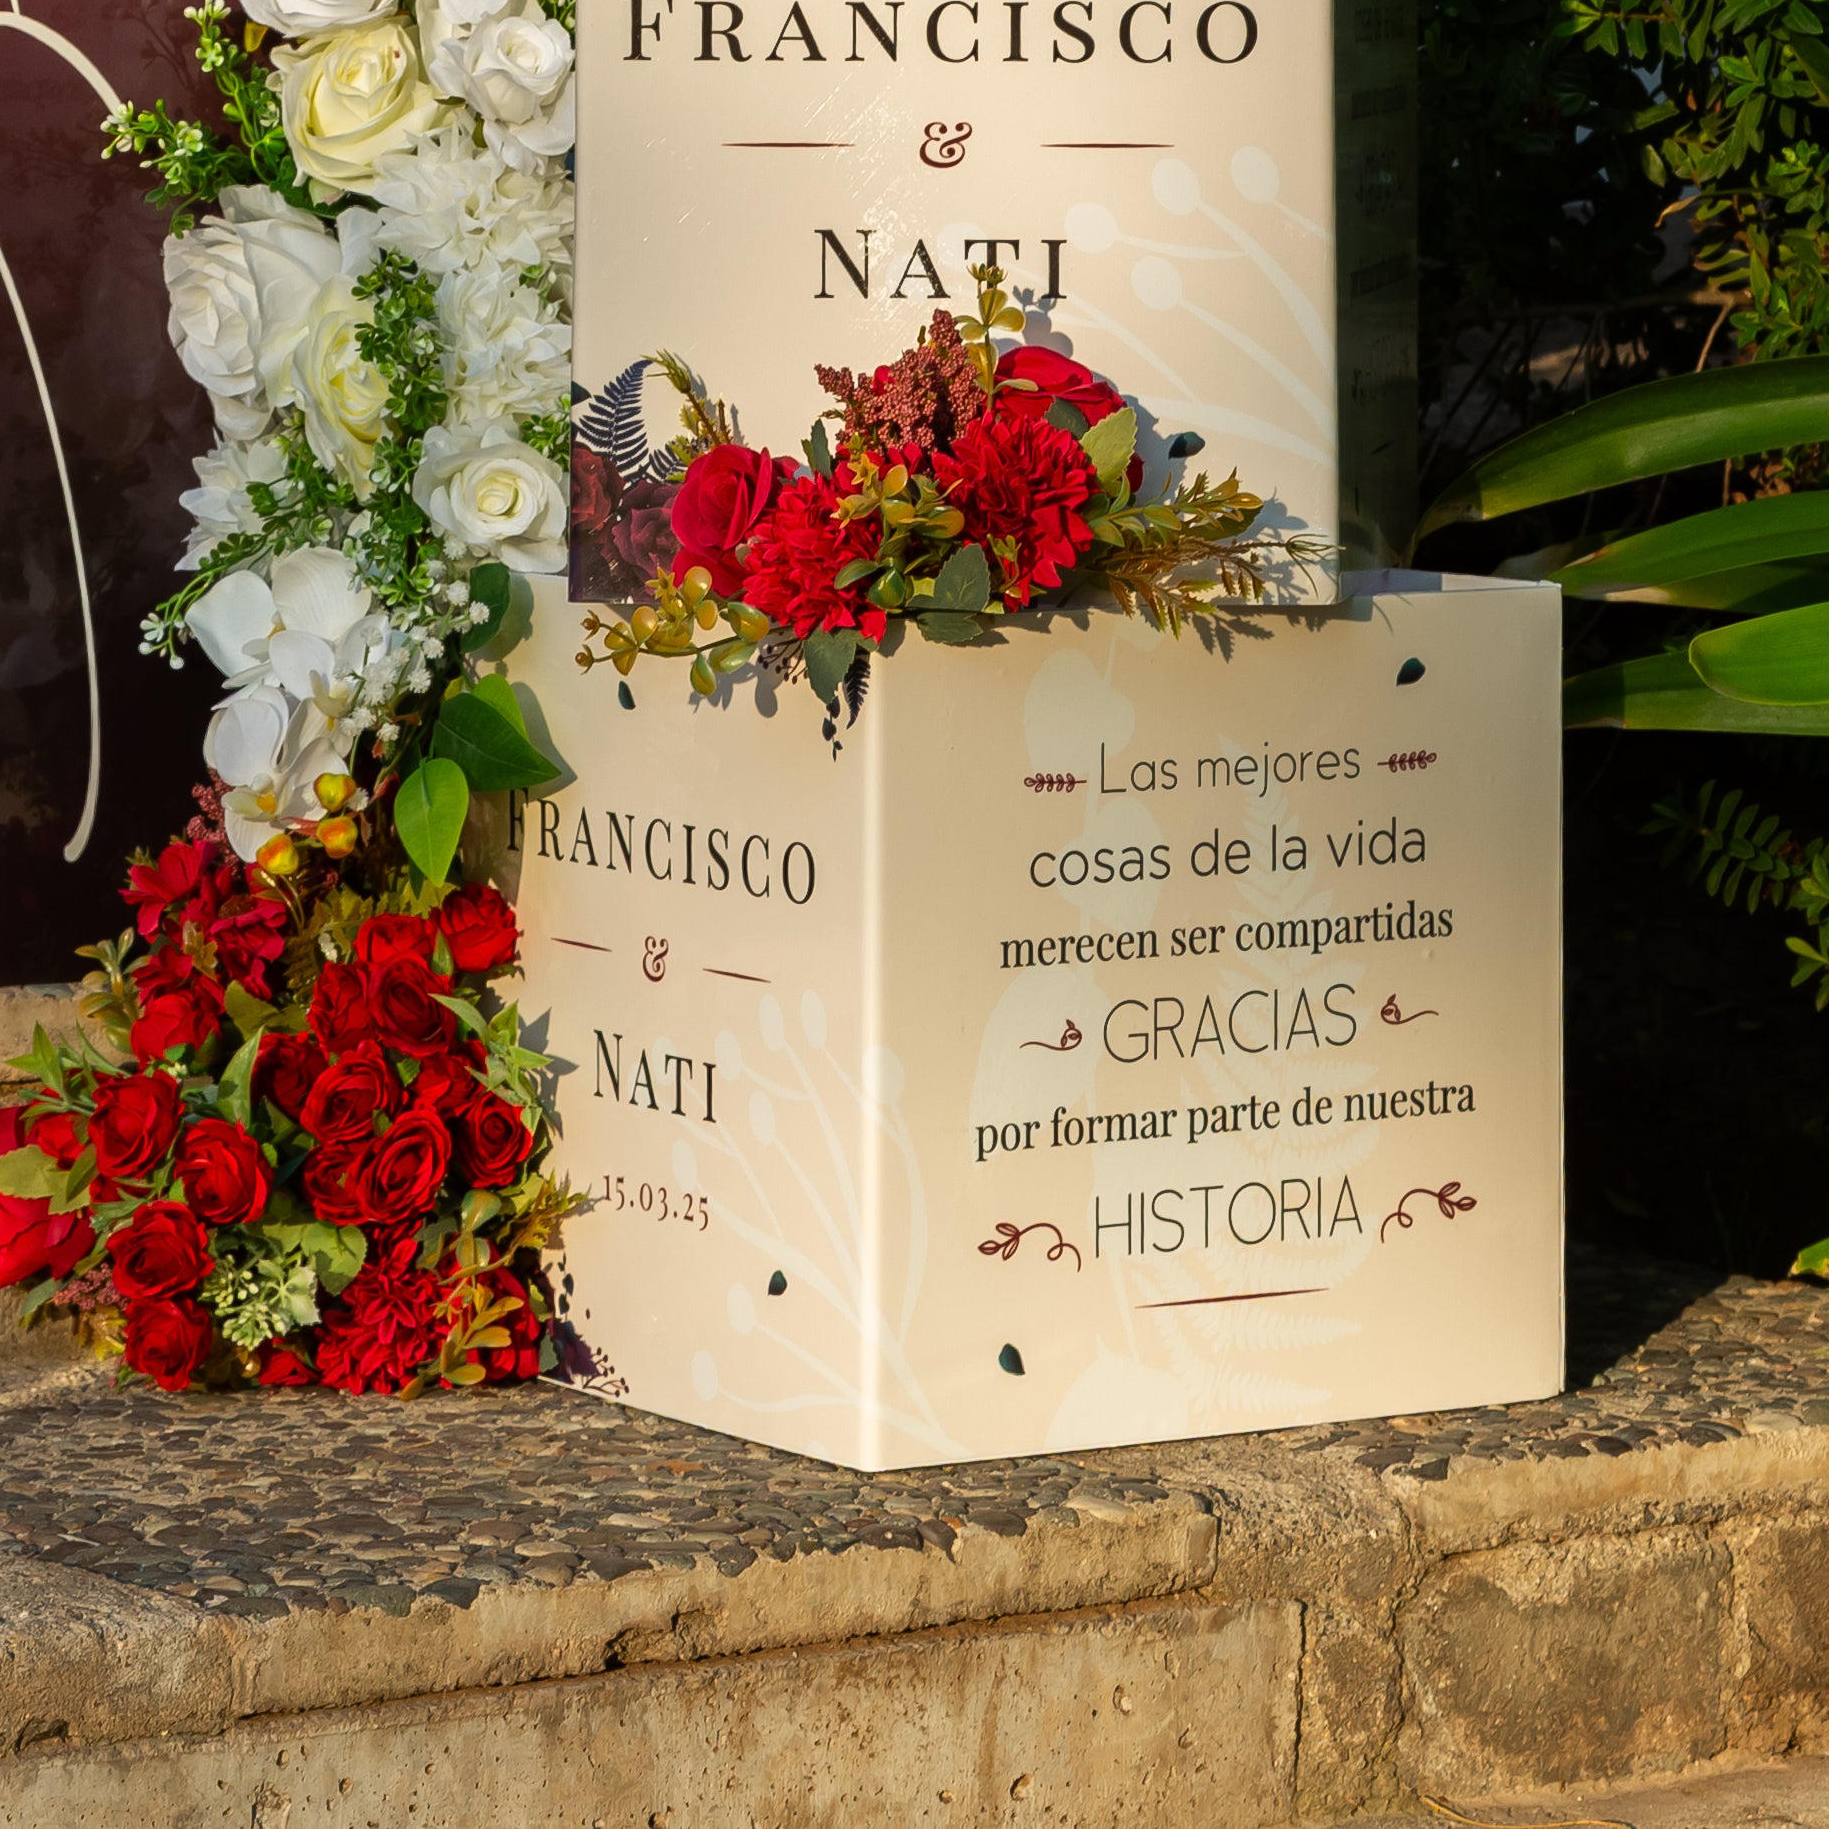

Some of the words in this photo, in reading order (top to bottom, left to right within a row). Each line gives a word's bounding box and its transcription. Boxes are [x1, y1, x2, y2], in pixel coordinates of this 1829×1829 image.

[919, 121, 973, 169] &
[813, 229, 1068, 300] NATI
[1100, 742, 1178, 794] Las
[1197, 741, 1361, 798] mejores
[506, 785, 816, 907] FRANCISCO
[1029, 844, 1171, 888] cosas
[1190, 827, 1251, 877] de
[1271, 824, 1307, 872] la
[1326, 816, 1426, 868] vida
[642, 935, 669, 983] &
[1000, 930, 1160, 969] merecen
[1170, 925, 1226, 957] ser
[1235, 899, 1453, 955] compartidas
[1103, 983, 1357, 1064] GRACIAS
[593, 1029, 717, 1124] NATI
[975, 1120, 1041, 1163] por
[1050, 1106, 1178, 1148] formar
[1187, 1095, 1281, 1144] parte
[1292, 1086, 1333, 1127] de
[1344, 1080, 1477, 1123] nuestra
[601, 1174, 711, 1232] 15.03.25
[1095, 1174, 1363, 1259] HISTORIA
